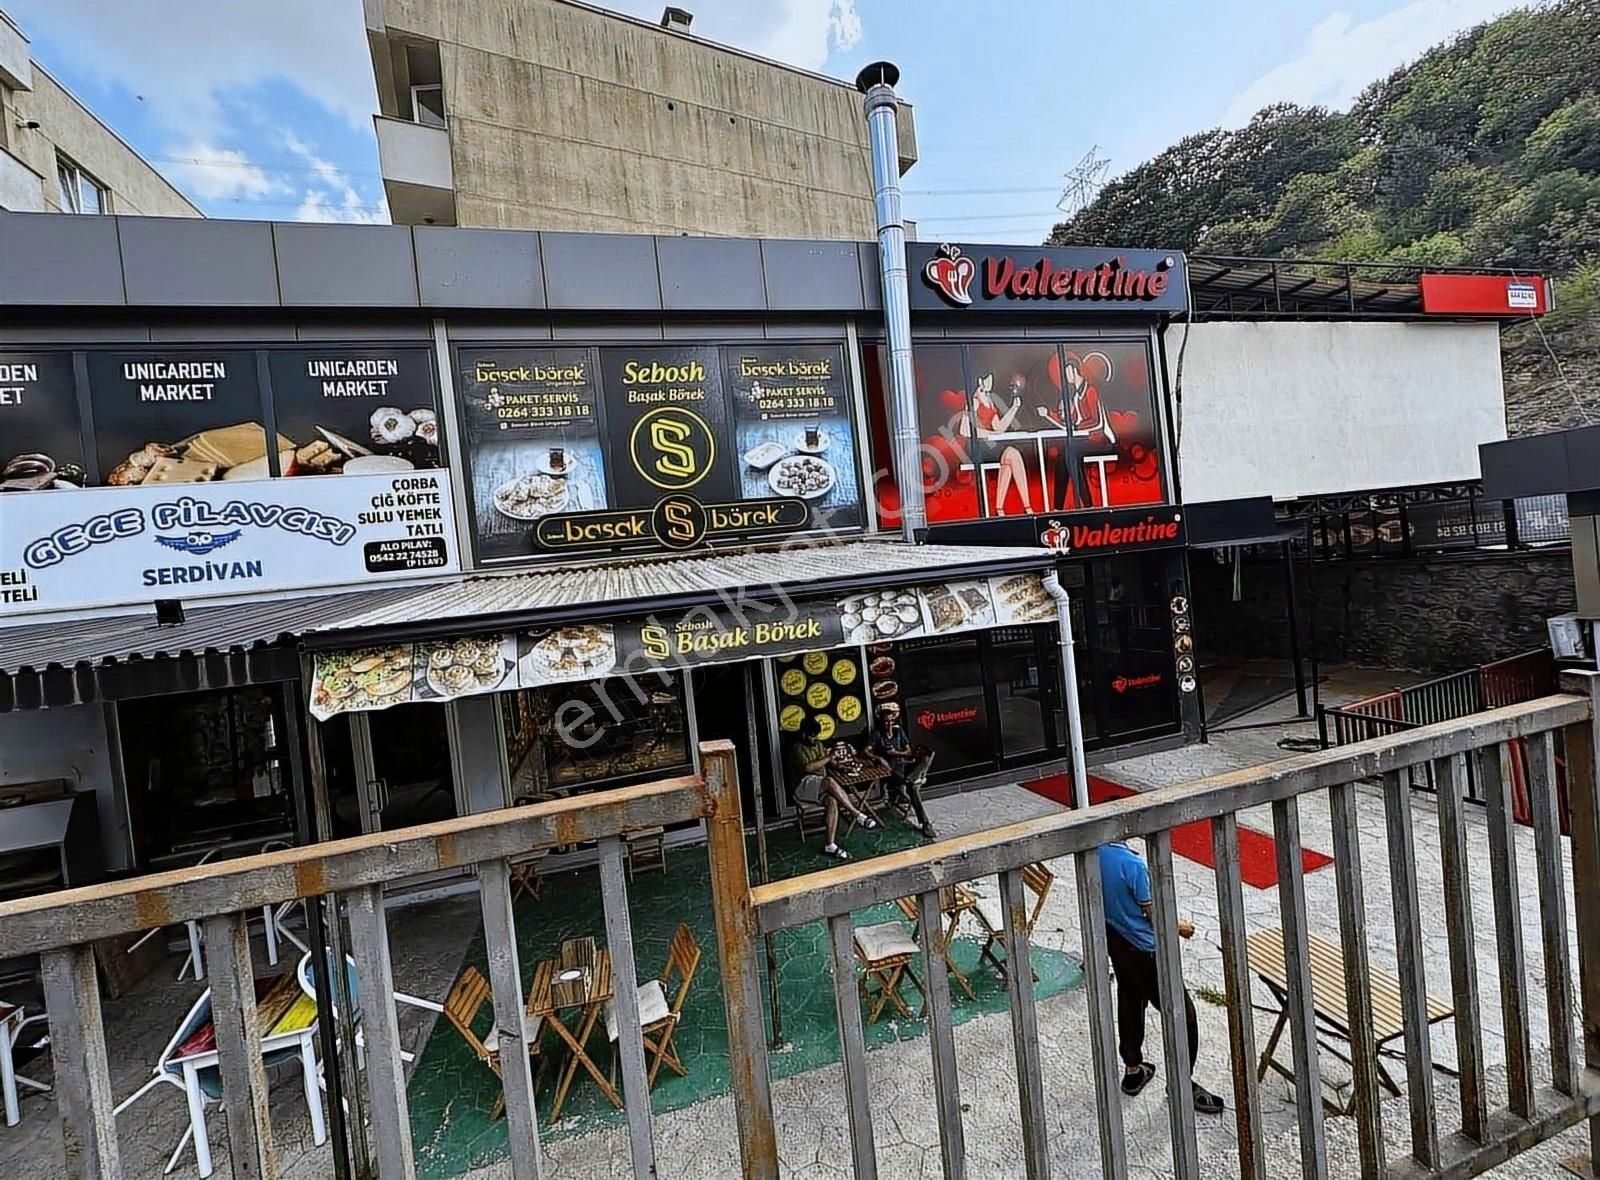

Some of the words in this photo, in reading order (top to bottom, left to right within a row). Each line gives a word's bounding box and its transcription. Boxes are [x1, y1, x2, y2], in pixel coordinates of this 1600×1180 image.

[986, 256, 1168, 298] Valentine
[124, 362, 226, 380] UNIGARDEN
[308, 360, 398, 377] UNIGARDEN
[534, 365, 584, 381] börek
[623, 360, 706, 385] Sebosh
[789, 361, 829, 375] börek
[140, 384, 214, 401] MARKET
[322, 380, 388, 397] MARKET
[628, 390, 667, 404] Başak
[669, 388, 705, 402] Börek
[766, 387, 795, 397] PAKET
[505, 394, 541, 405] PAKET
[759, 399, 785, 409] 0264
[786, 398, 805, 408] 333
[809, 397, 820, 407] 18
[823, 397, 834, 407] 18
[498, 408, 528, 418] 0264
[531, 407, 554, 417] 333
[558, 405, 571, 416] 18
[576, 405, 590, 416] 18
[392, 477, 439, 493] ÇORBA
[371, 492, 394, 510] ÇİĞ
[397, 491, 440, 506] KÖFTE
[358, 511, 394, 524] SULU
[396, 508, 442, 521] YEMEK
[712, 503, 781, 530] börek
[24, 508, 145, 569] GECE
[152, 496, 356, 546] PİLAVCISI
[406, 522, 444, 536] TATLI
[1073, 516, 1178, 549] Valentine
[380, 542, 399, 551] ALO
[369, 553, 394, 562] 0542
[396, 552, 408, 561] 22
[142, 560, 263, 587] SERDİVAN
[677, 627, 749, 654] Başak
[754, 618, 822, 645] Börek
